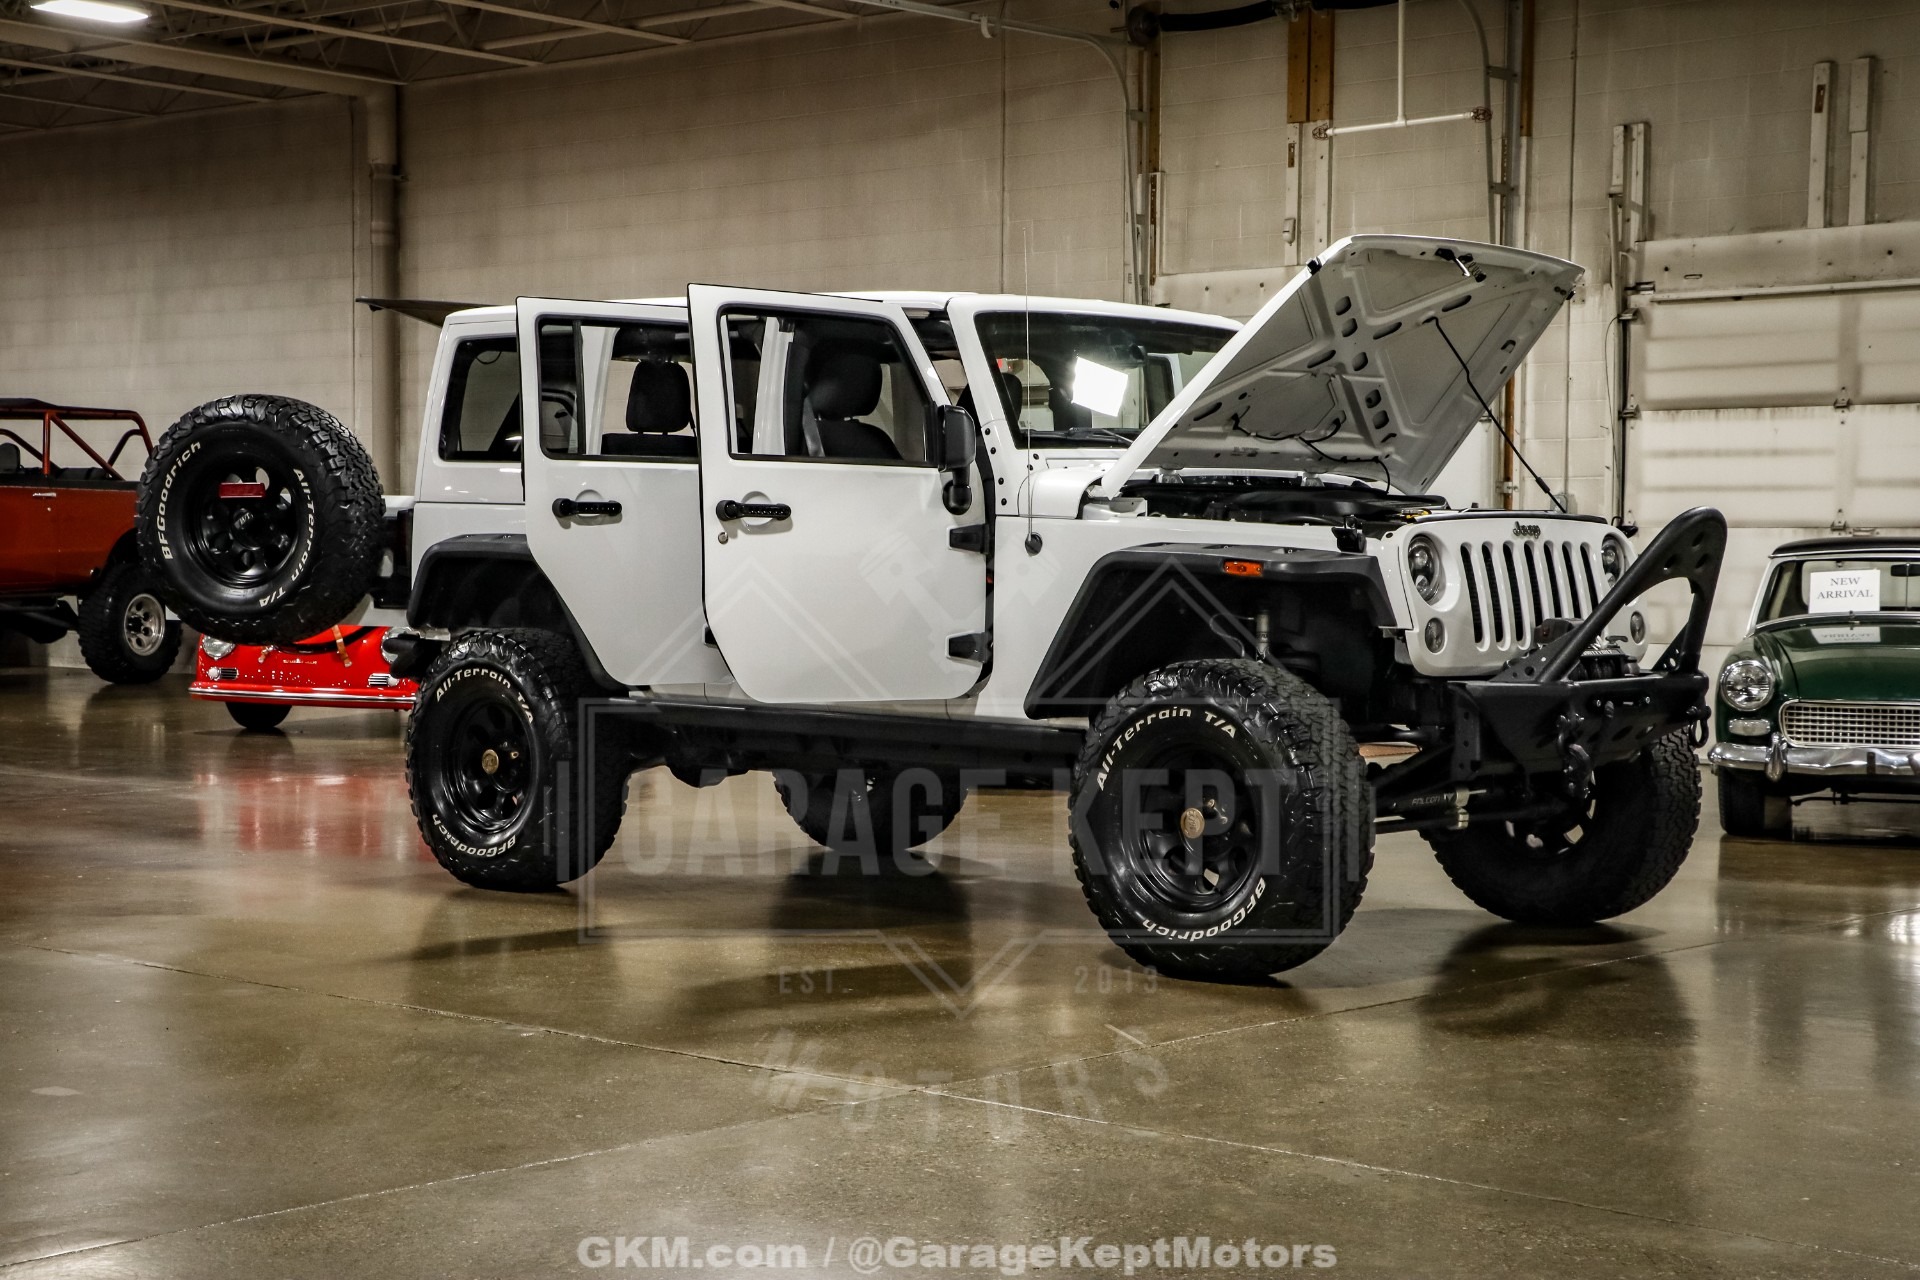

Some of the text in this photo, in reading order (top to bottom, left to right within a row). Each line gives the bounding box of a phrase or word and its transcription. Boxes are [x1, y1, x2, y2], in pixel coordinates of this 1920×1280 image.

[157, 441, 201, 560] BFGoodrich
[258, 467, 315, 608] All-Terrain T/A
[1816, 589, 1874, 600] ARRIVAL
[1830, 577, 1861, 587] NEW
[435, 667, 534, 724] All-Terrain T/A
[1096, 705, 1237, 791] All-Terrain T/A
[432, 813, 517, 857] BFGoodrich
[1142, 876, 1266, 942] BFGoodrich
